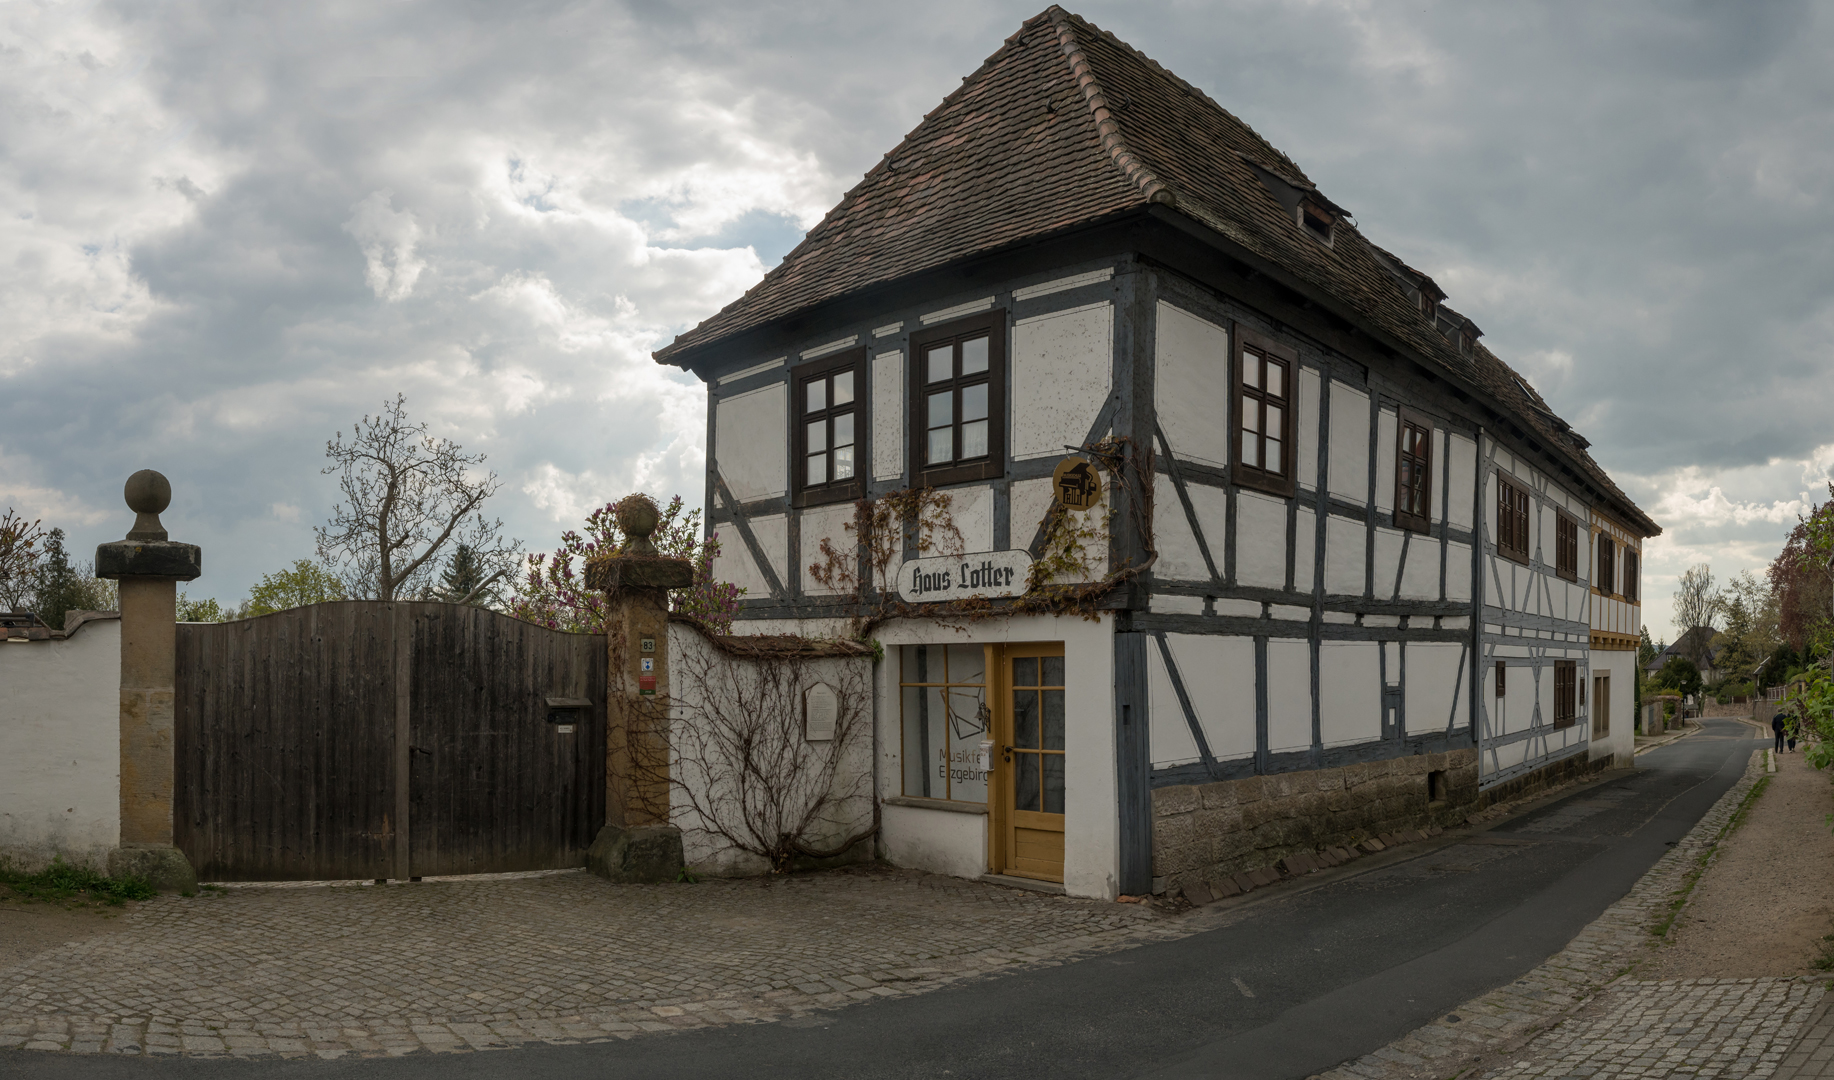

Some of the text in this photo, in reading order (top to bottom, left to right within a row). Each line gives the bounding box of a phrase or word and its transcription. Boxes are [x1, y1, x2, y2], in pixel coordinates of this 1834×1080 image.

[909, 560, 1014, 595] Haus Lotter
[643, 641, 653, 650] 83
[939, 765, 988, 786] Ezgebirg
